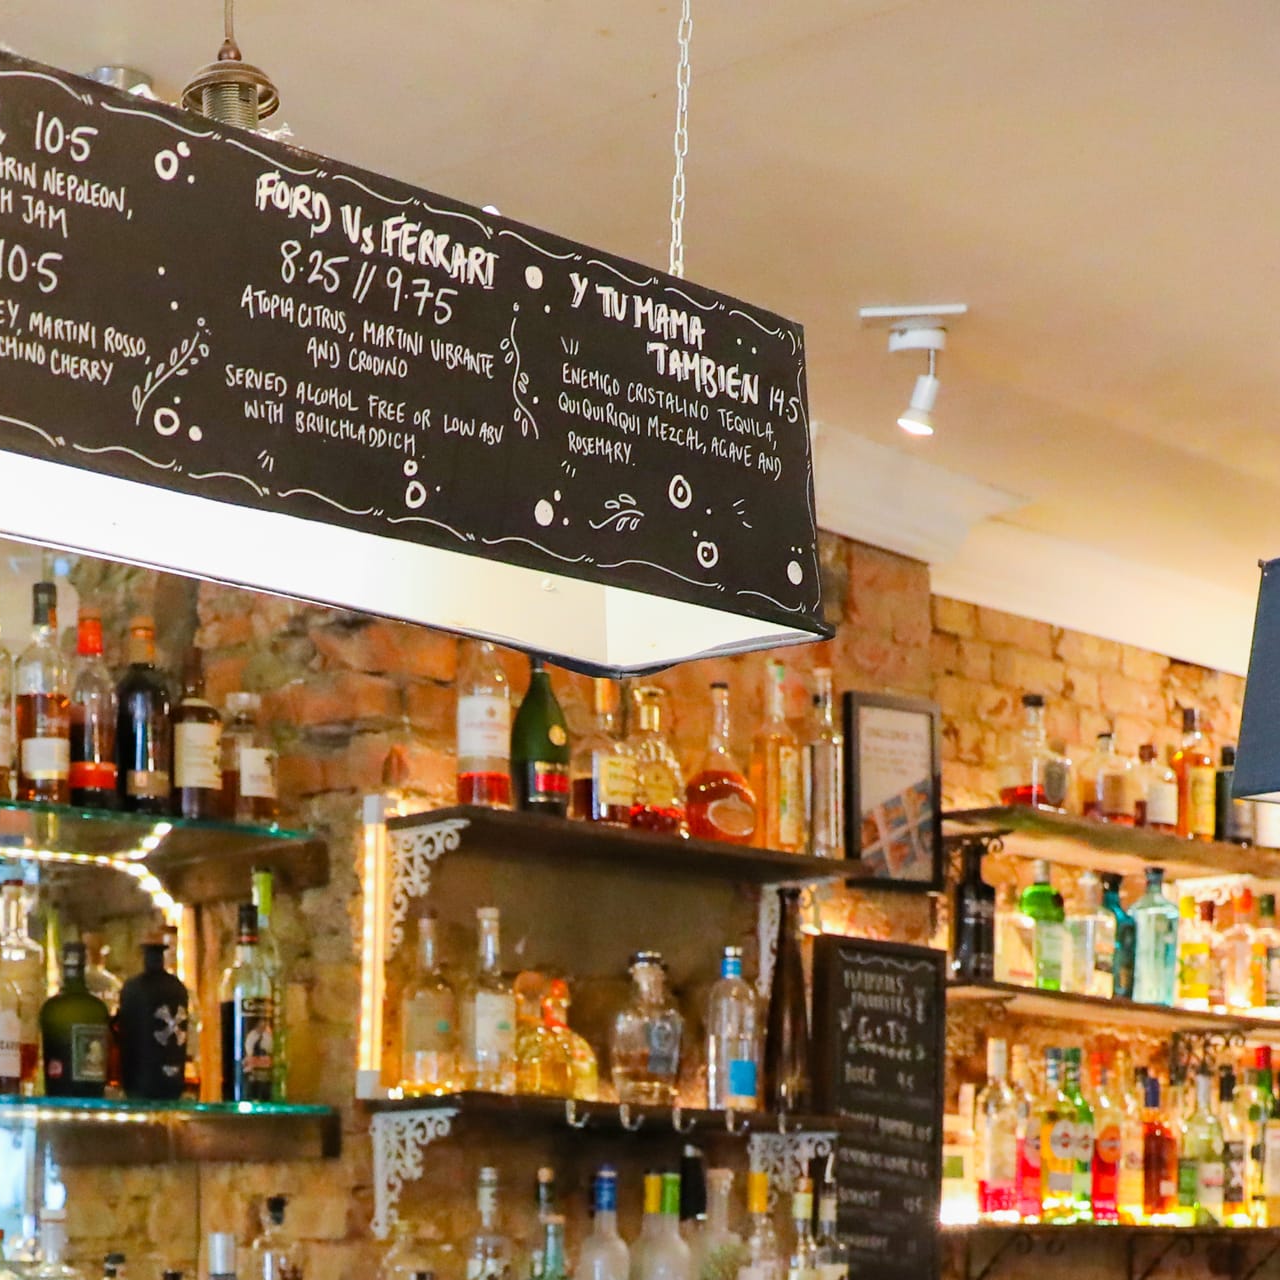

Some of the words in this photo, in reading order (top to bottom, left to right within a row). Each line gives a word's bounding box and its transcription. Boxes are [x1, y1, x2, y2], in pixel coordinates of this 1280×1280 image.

[21, 195, 68, 239] JAM
[43, 167, 133, 220] NEPOLEON,
[255, 170, 332, 238] FORD
[381, 212, 500, 290] FERRARI
[280, 239, 350, 293] 8.25
[386, 266, 459, 325] 9.75
[570, 272, 588, 308] Y
[595, 283, 629, 321] TU
[633, 295, 706, 350] MAMA
[29, 311, 97, 349] MARTINI
[104, 325, 151, 365] ROSSO,
[241, 284, 295, 325] ATOPIA
[363, 320, 424, 356] MARTINI
[430, 338, 495, 380] VIBRANTE
[307, 336, 341, 369] AND
[348, 347, 409, 379] CRODINO
[50, 348, 114, 386] CHERRY
[562, 362, 620, 395] ENEMIGO
[627, 382, 709, 421] CRISTALINO
[647, 341, 759, 404] TAMBIEN
[225, 364, 288, 397] SERVED
[296, 381, 359, 412] ALCOHOL
[368, 395, 406, 424] FREE
[413, 408, 431, 431] OR
[443, 414, 475, 437] LOW
[479, 421, 505, 446] ABV
[244, 399, 284, 425] WITH
[648, 415, 707, 454] MEZCAL,
[711, 436, 752, 467] AGAVE
[758, 454, 782, 481] AND
